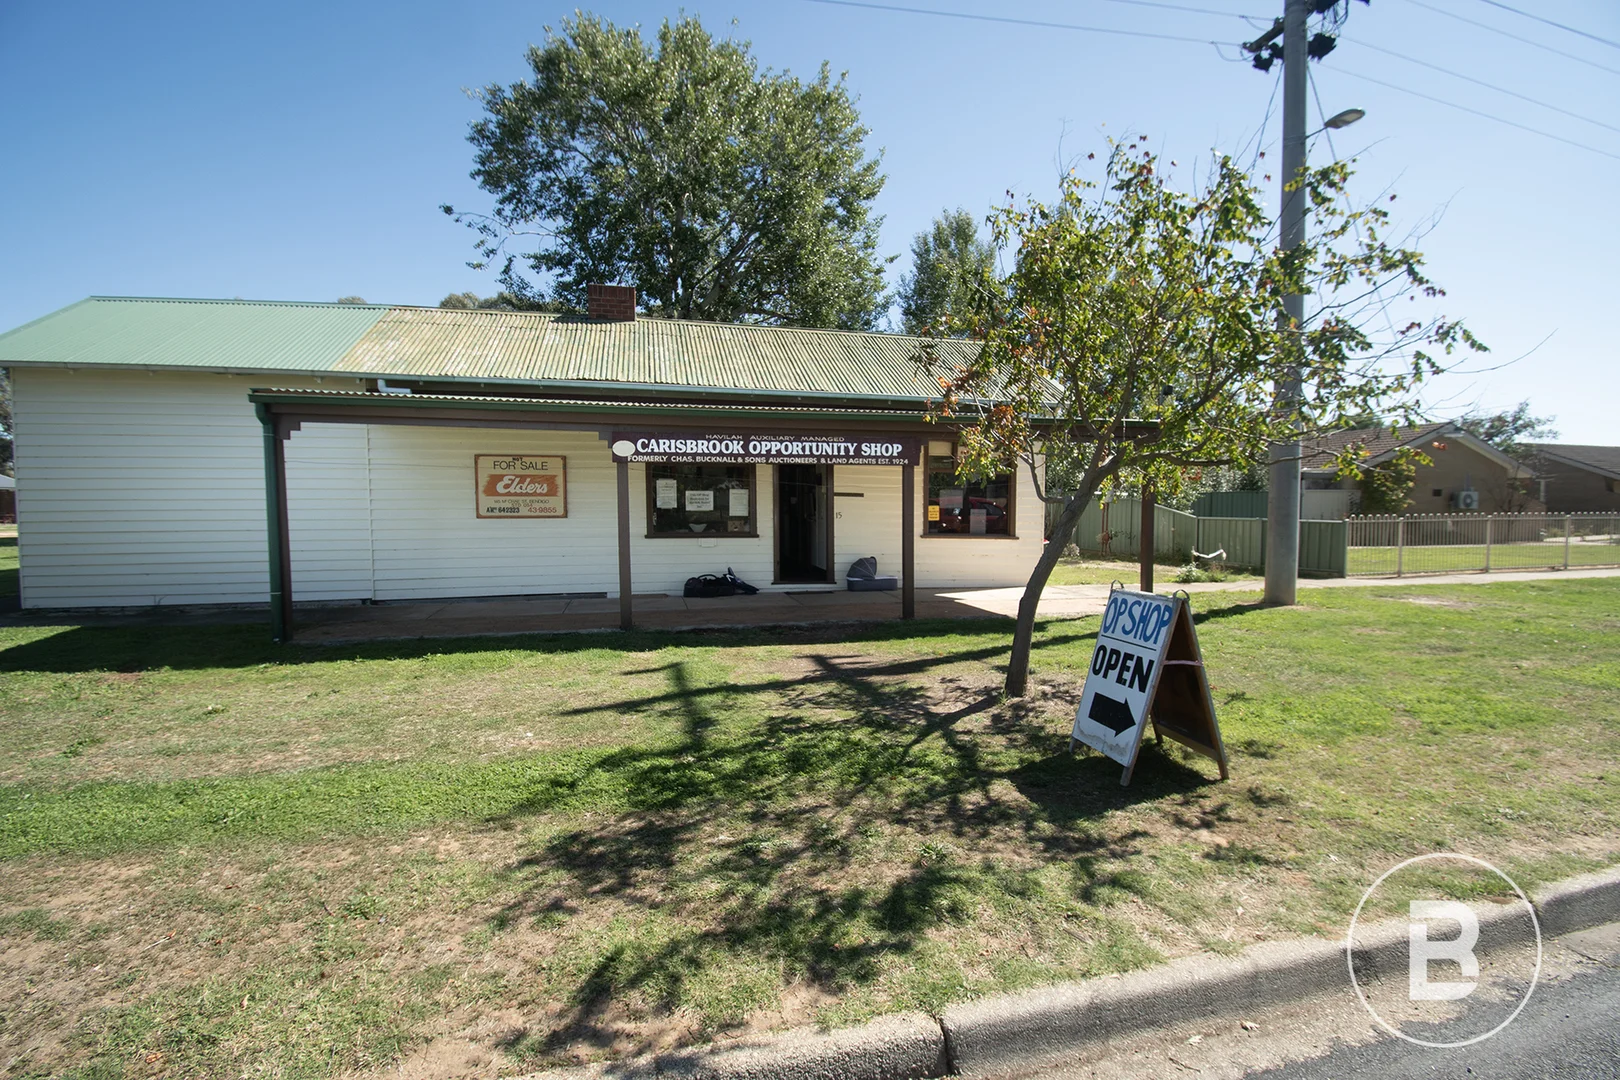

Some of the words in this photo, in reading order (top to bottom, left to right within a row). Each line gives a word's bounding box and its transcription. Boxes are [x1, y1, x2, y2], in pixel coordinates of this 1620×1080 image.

[636, 438, 745, 454] CARISBROOK
[748, 441, 858, 456] OPPORTUNITY
[861, 442, 903, 457] SHOP
[493, 460, 516, 470] FOR
[520, 461, 548, 471] SALE
[496, 475, 548, 494] Elders
[1092, 645, 1155, 694] OPEN
